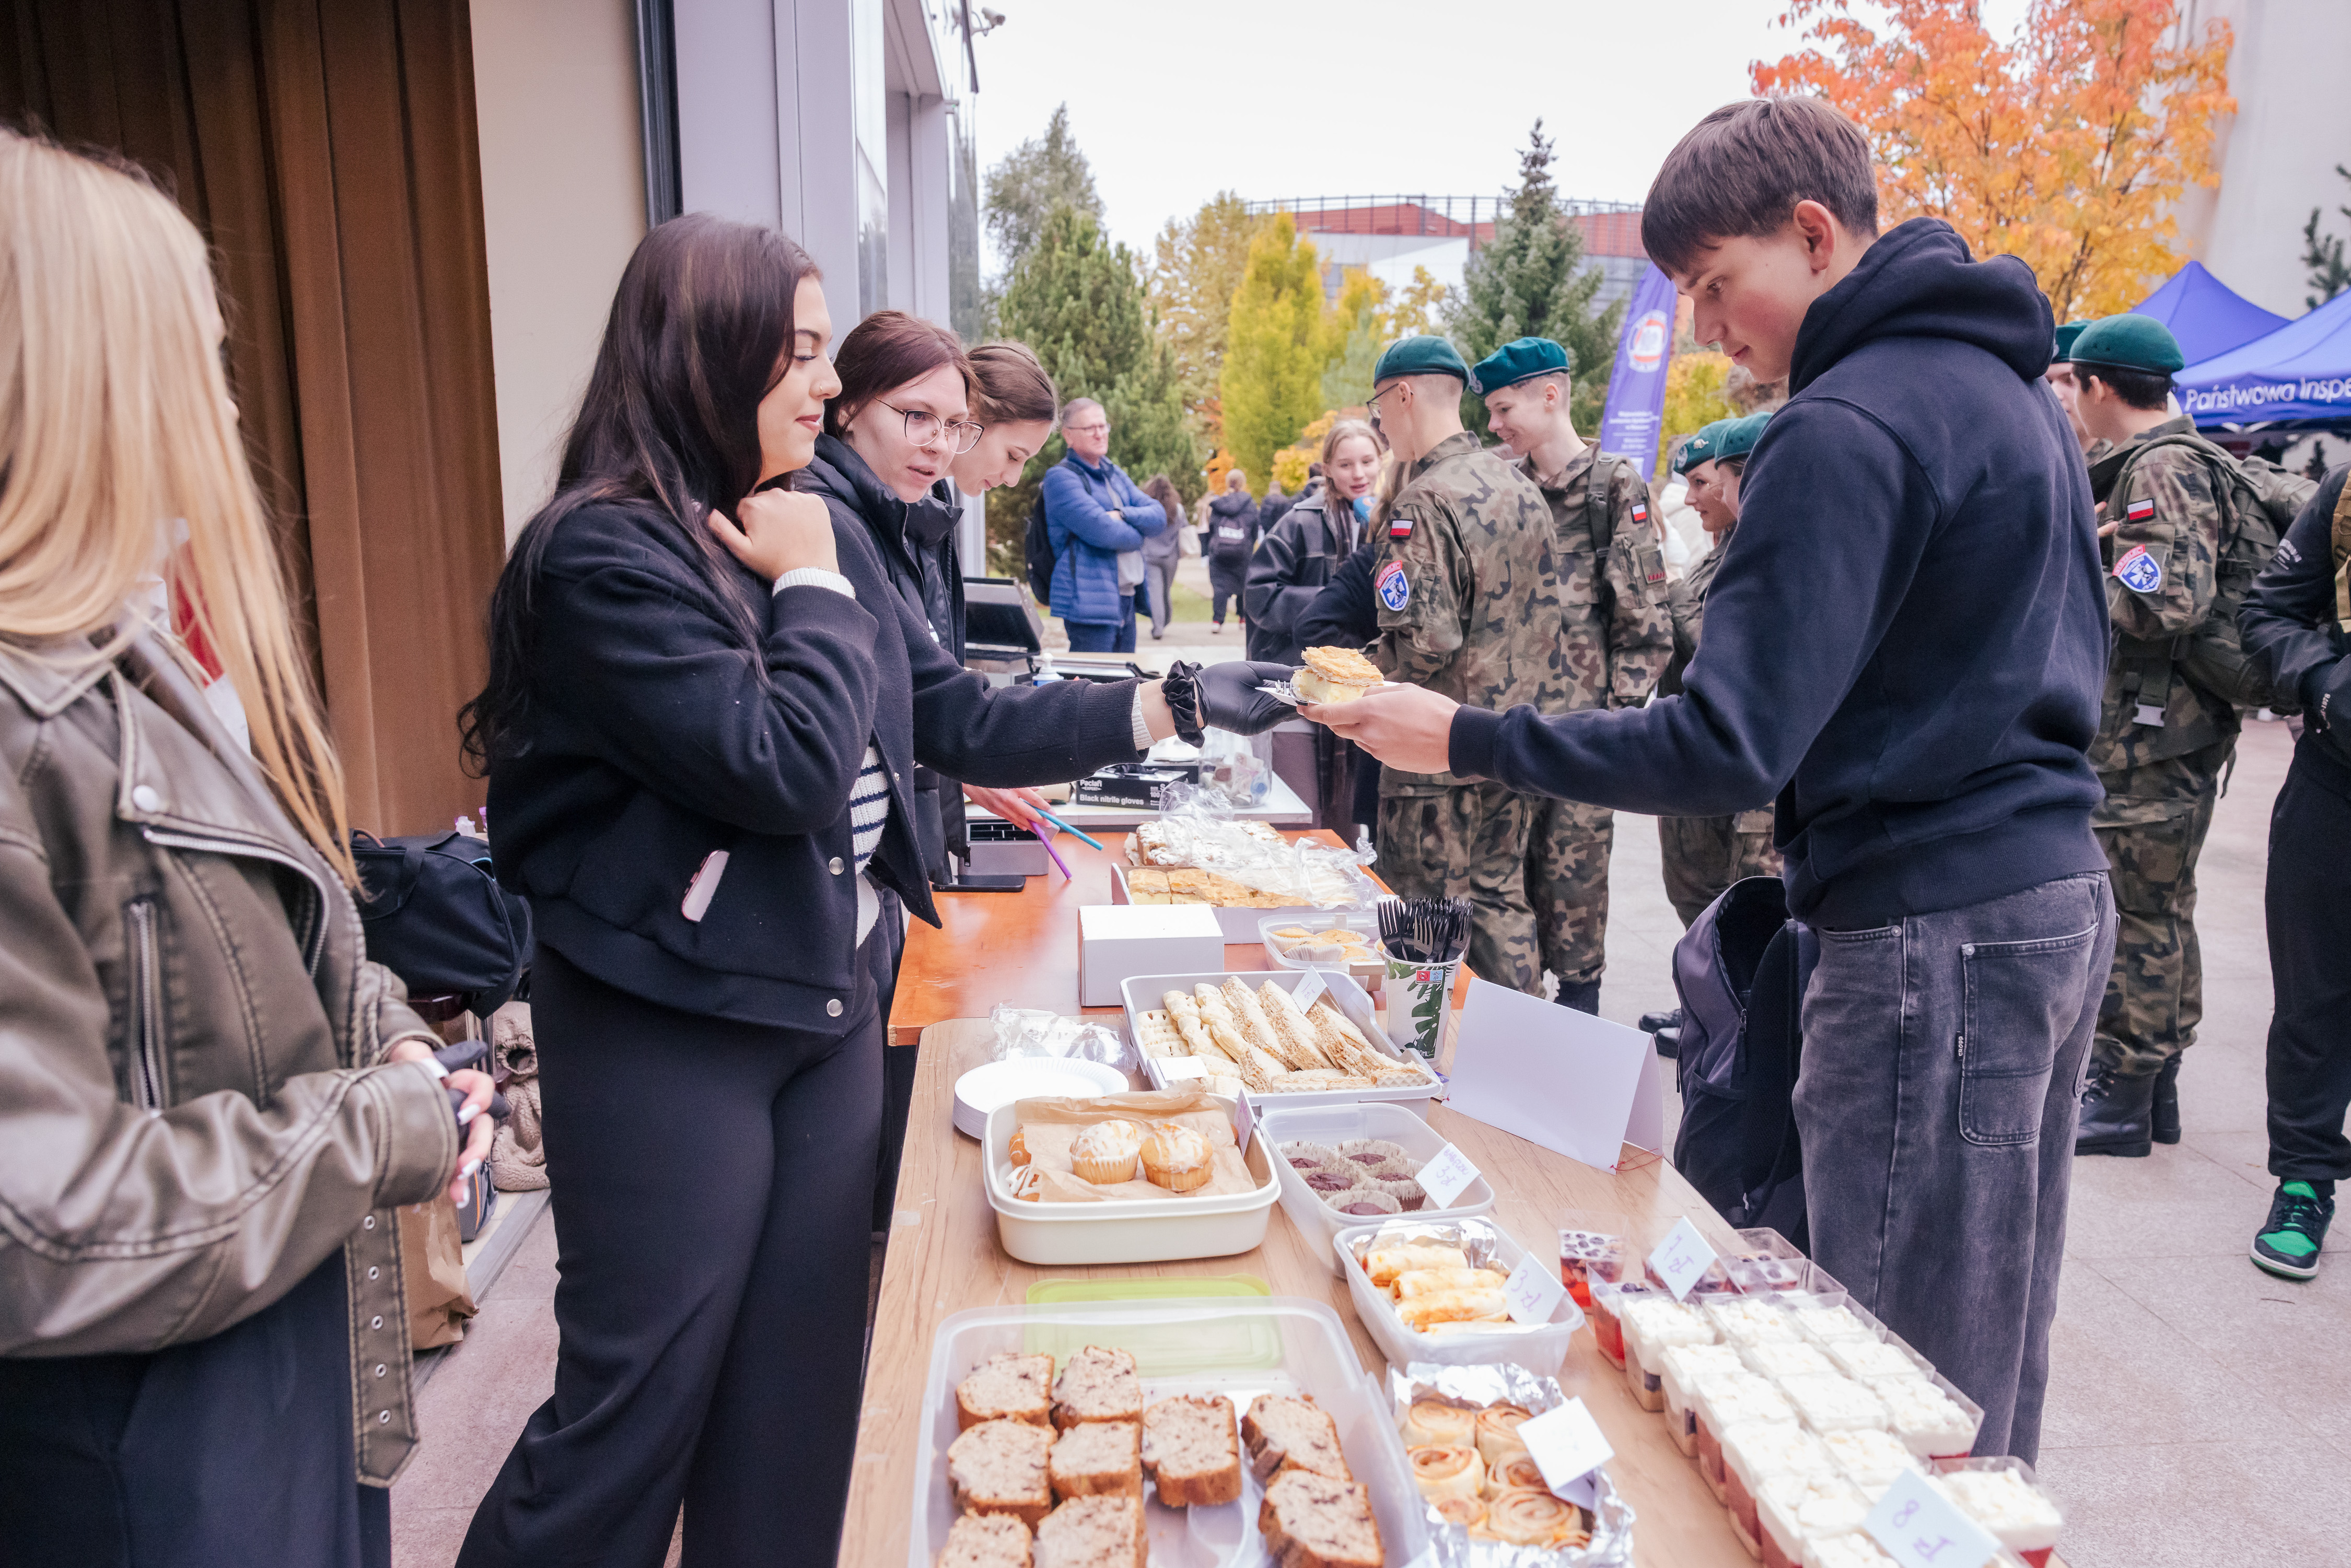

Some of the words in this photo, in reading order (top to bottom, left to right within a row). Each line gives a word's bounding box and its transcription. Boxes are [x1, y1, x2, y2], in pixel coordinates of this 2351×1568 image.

[1079, 793, 1099, 802] Black
[1121, 797, 1144, 805] gloves
[1510, 1269, 1529, 1292] 3
[1892, 1498, 1921, 1529] 8
